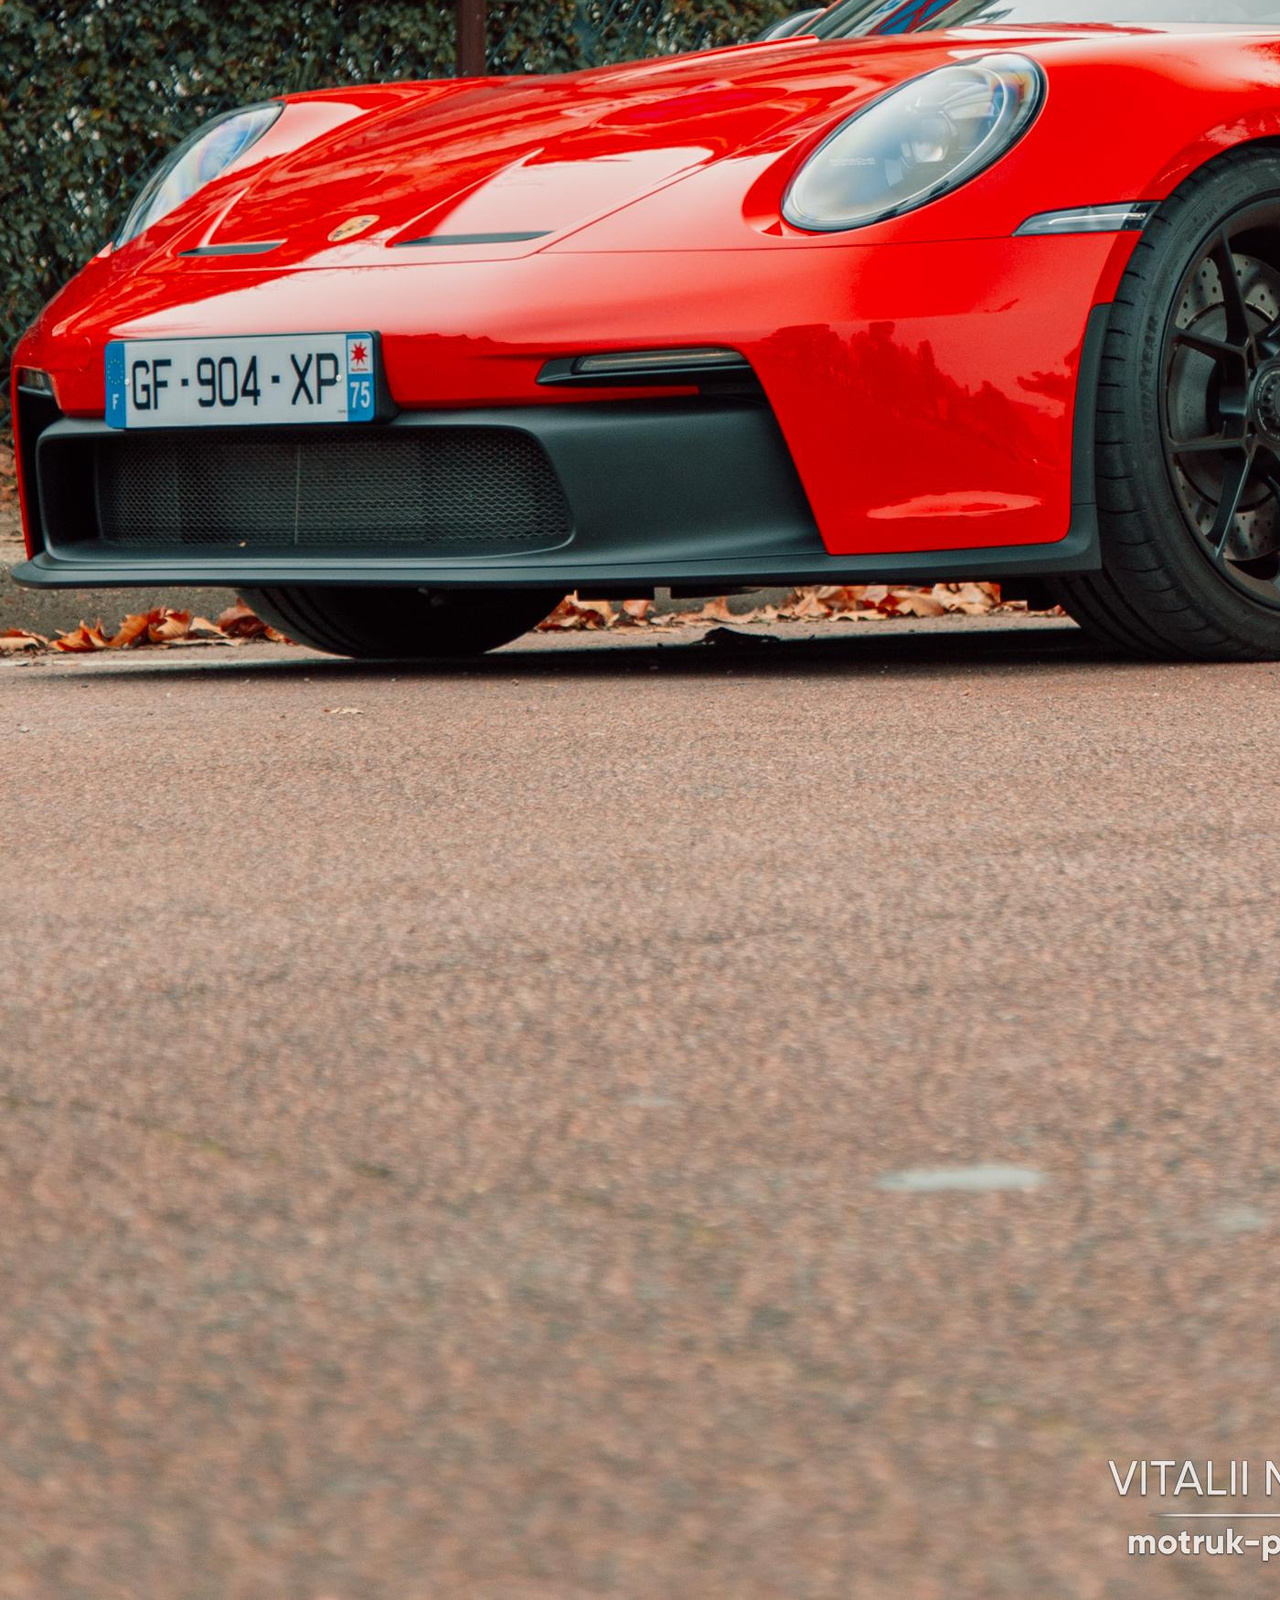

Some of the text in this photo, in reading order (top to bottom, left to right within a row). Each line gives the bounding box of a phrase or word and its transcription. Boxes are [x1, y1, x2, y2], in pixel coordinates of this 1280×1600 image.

[131, 352, 339, 410] GF-904-XP
[350, 381, 371, 409] 75
[111, 393, 119, 410] F
